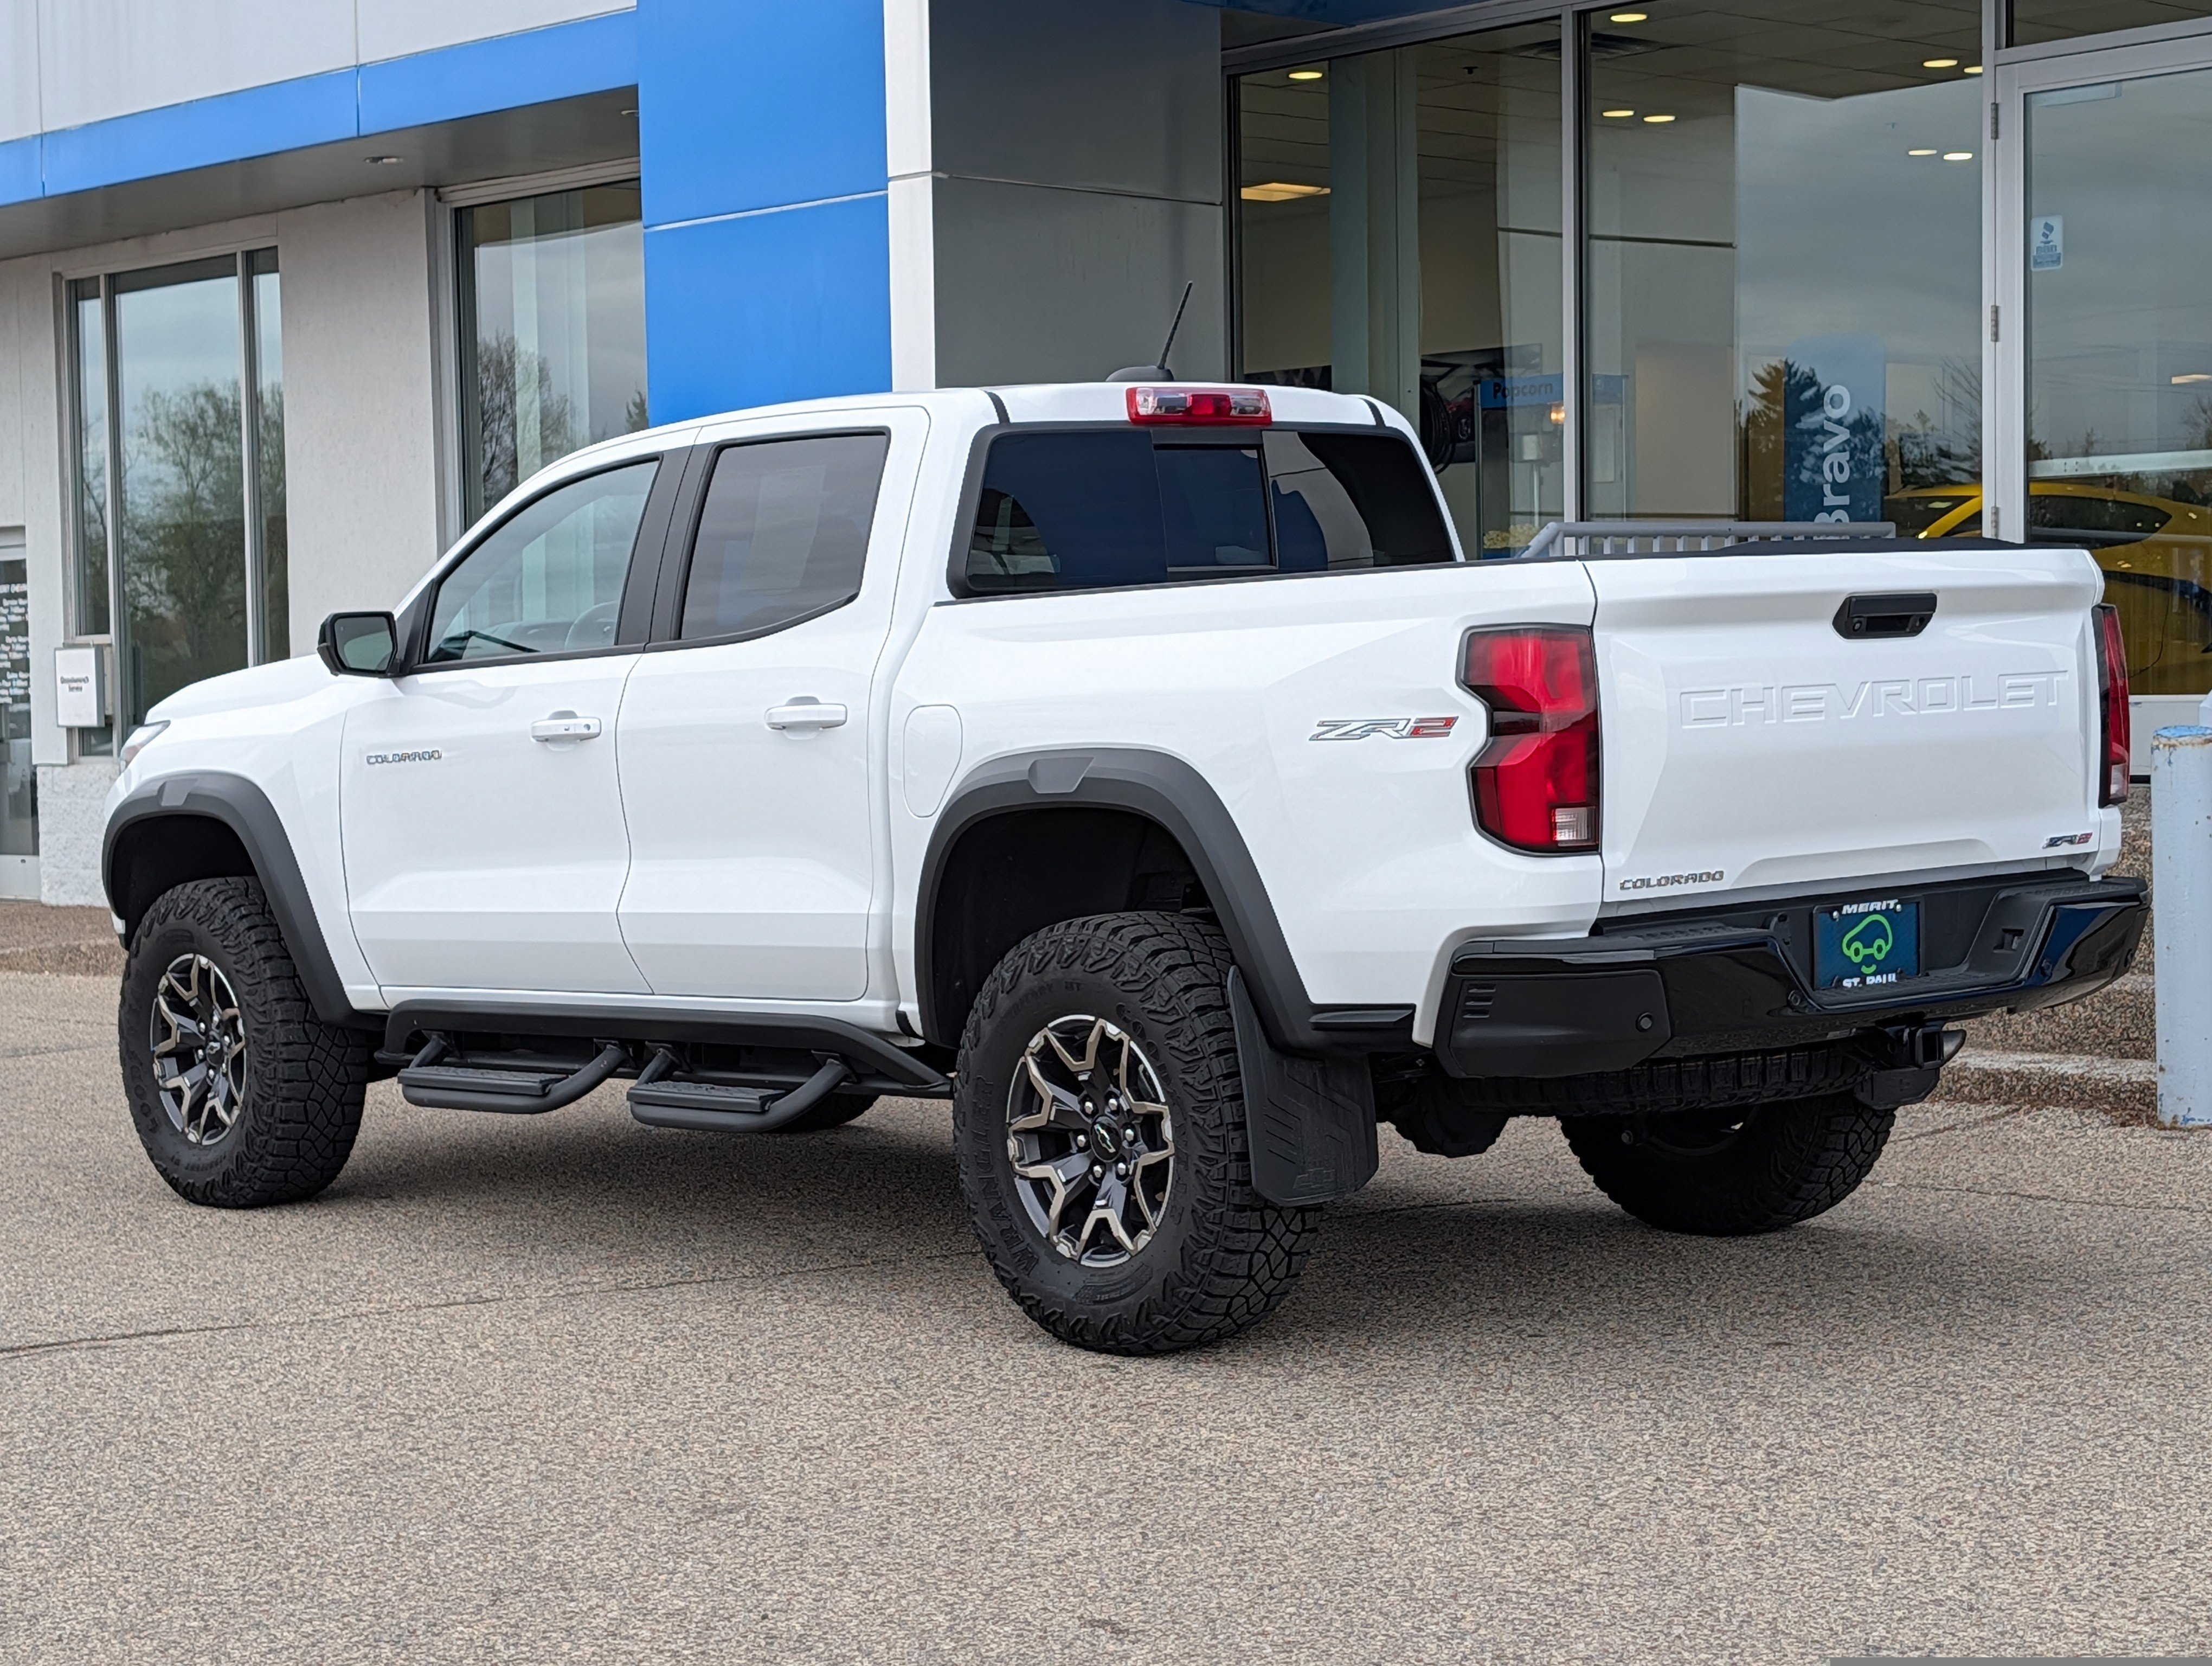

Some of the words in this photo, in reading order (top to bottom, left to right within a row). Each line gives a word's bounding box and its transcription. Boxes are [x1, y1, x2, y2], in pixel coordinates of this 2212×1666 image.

[1493, 382, 1553, 400] Popcorn
[1680, 670, 2069, 729] CHEVROLET
[1308, 716, 1459, 741] ZR2
[366, 750, 442, 765] COLORADO
[1619, 870, 1724, 890] COLORADO
